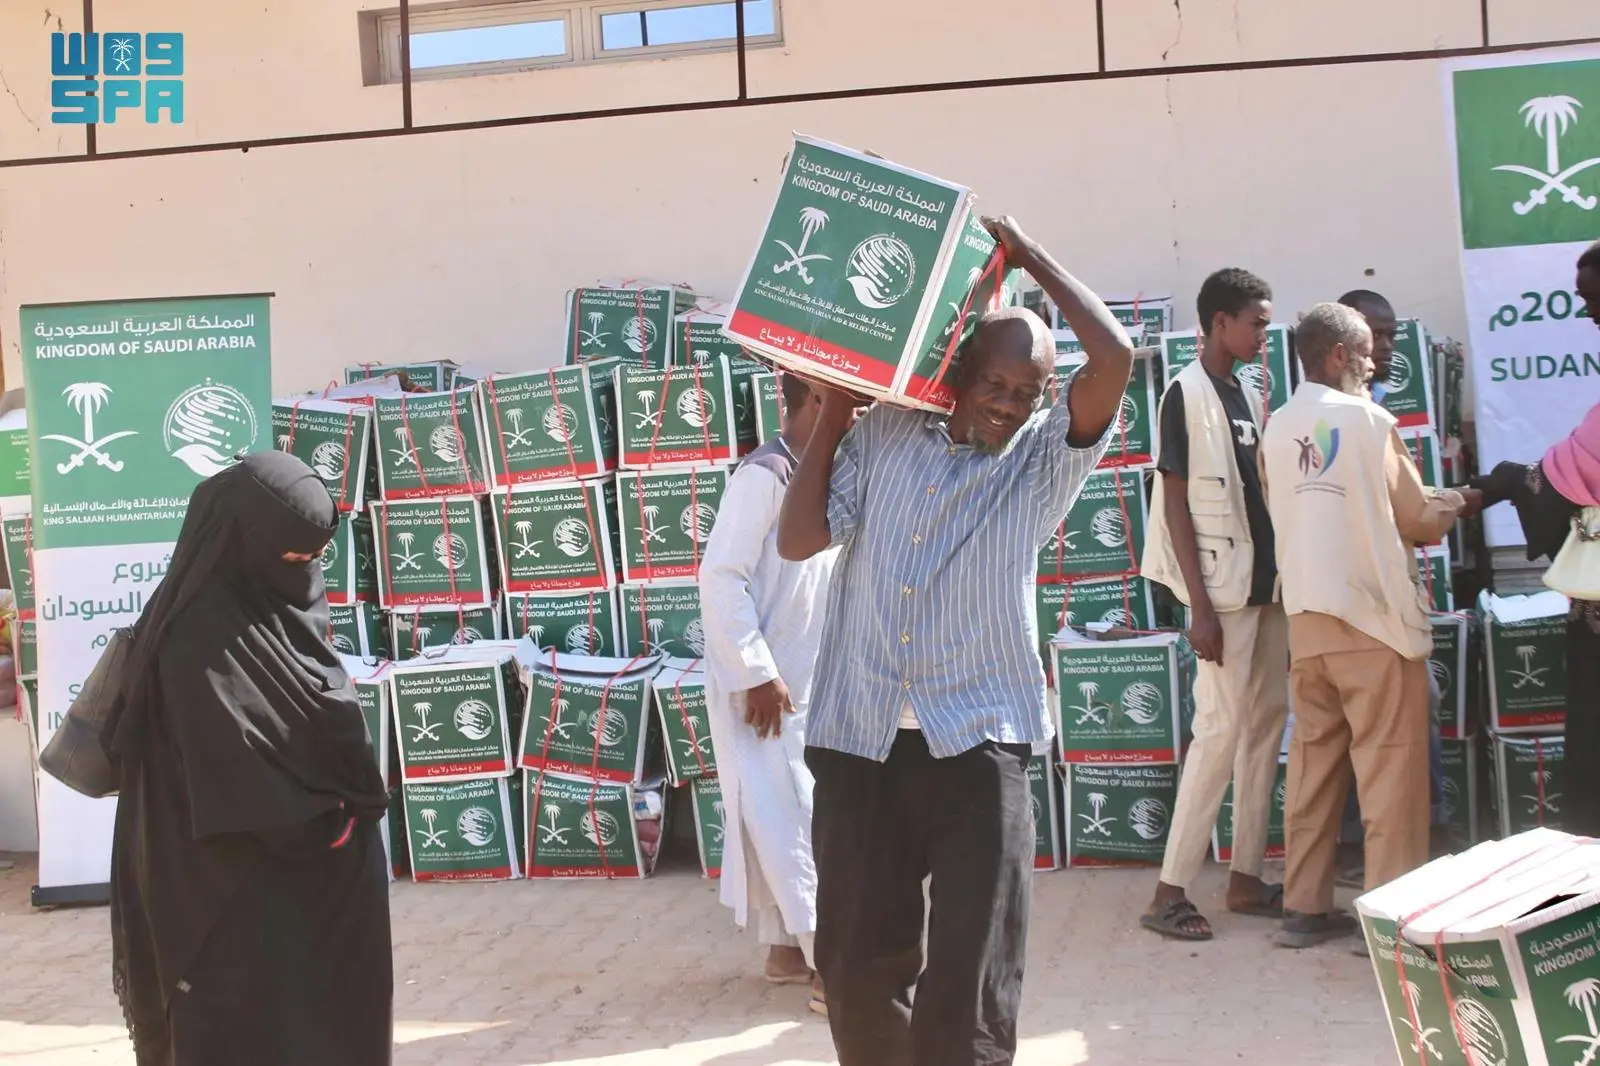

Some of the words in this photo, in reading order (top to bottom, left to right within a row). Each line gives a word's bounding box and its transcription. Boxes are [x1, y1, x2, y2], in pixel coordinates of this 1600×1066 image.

[798, 155, 850, 183] السعودية
[852, 172, 894, 196] العربية
[792, 175, 839, 198] KINGDOM
[841, 190, 857, 203] OF
[858, 196, 892, 215] SAUDI
[894, 208, 937, 231] ARABIA
[895, 186, 945, 213] المملكة
[186, 314, 254, 329] المملكة
[768, 292, 789, 304] SALMAN
[789, 299, 831, 319] HUMANITARIAN
[832, 314, 842, 323] AID
[848, 321, 869, 332] RELIEF
[869, 329, 893, 341] CENTER
[34, 321, 118, 341] السعودية
[123, 317, 182, 337] العربية
[36, 342, 115, 359] KINGDOM
[119, 341, 139, 354] OF
[144, 339, 193, 353] SAUDI
[197, 336, 256, 350] ARABIA
[1490, 352, 1600, 381] SUDAN
[627, 374, 655, 383] KINGDOM
[556, 386, 579, 394] RABIA
[420, 410, 440, 418] SAUDI
[310, 424, 329, 433] SAUDI
[169, 497, 190, 507] لمان
[1081, 491, 1104, 500] SAUDI
[44, 517, 64, 525] KING
[66, 515, 104, 524] SALMAN
[106, 511, 175, 522] HUMANITARIAN
[42, 591, 141, 621] السودان
[1063, 666, 1098, 674] KINGDOM
[1136, 664, 1164, 672] ARABIA
[400, 687, 432, 695] KINGDOM
[433, 686, 441, 694] OF
[466, 682, 491, 690] ARABIA
[572, 686, 583, 694] OF
[585, 688, 605, 697] SAUD
[609, 692, 637, 701] ARABIA
[1075, 777, 1108, 786] KINGDOM
[1122, 780, 1145, 788] SAUDI
[1146, 780, 1172, 788] ARABIA
[468, 788, 494, 798] ARABIA
[1530, 921, 1595, 957] السعودية
[1534, 944, 1596, 977] KINGDOM
